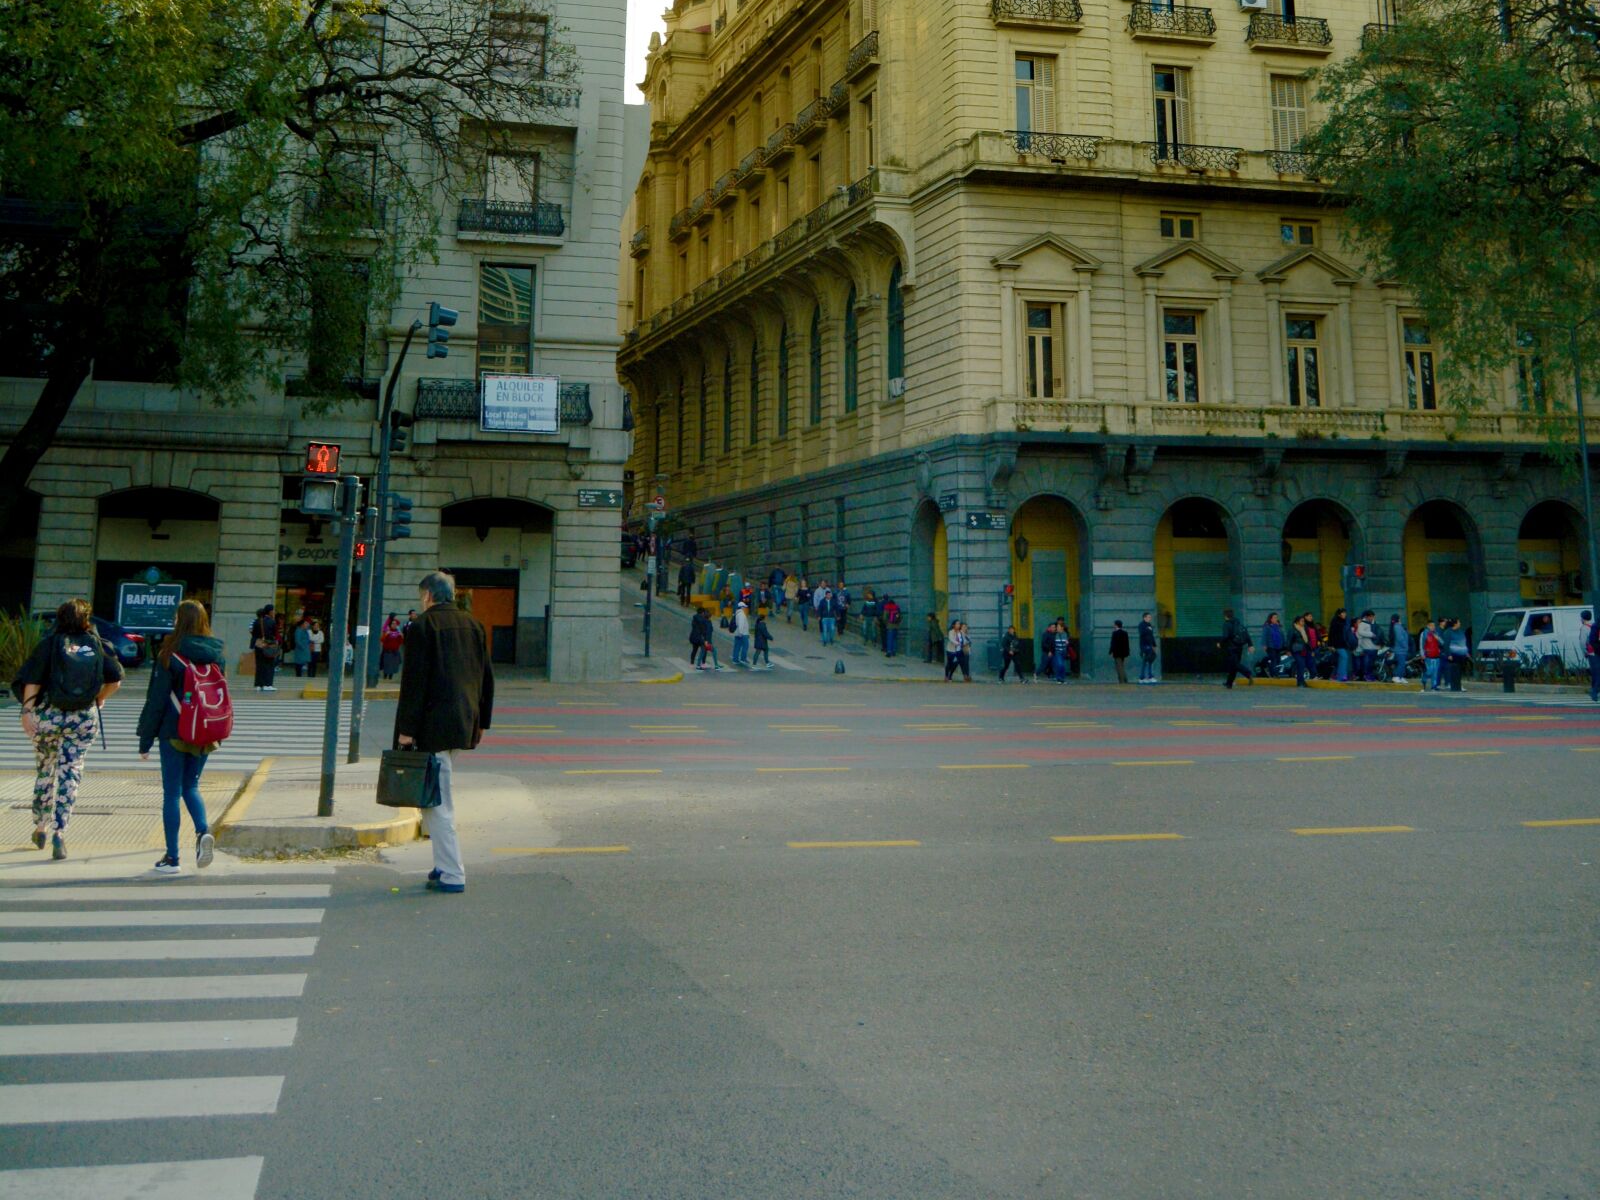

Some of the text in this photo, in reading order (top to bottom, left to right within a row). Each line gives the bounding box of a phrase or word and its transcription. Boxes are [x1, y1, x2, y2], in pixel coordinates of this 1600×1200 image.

[496, 381, 544, 392] ALQUILER
[496, 392, 543, 402] EN BLOCK
[297, 547, 339, 561] expre
[126, 594, 176, 605] BAFWEEK
